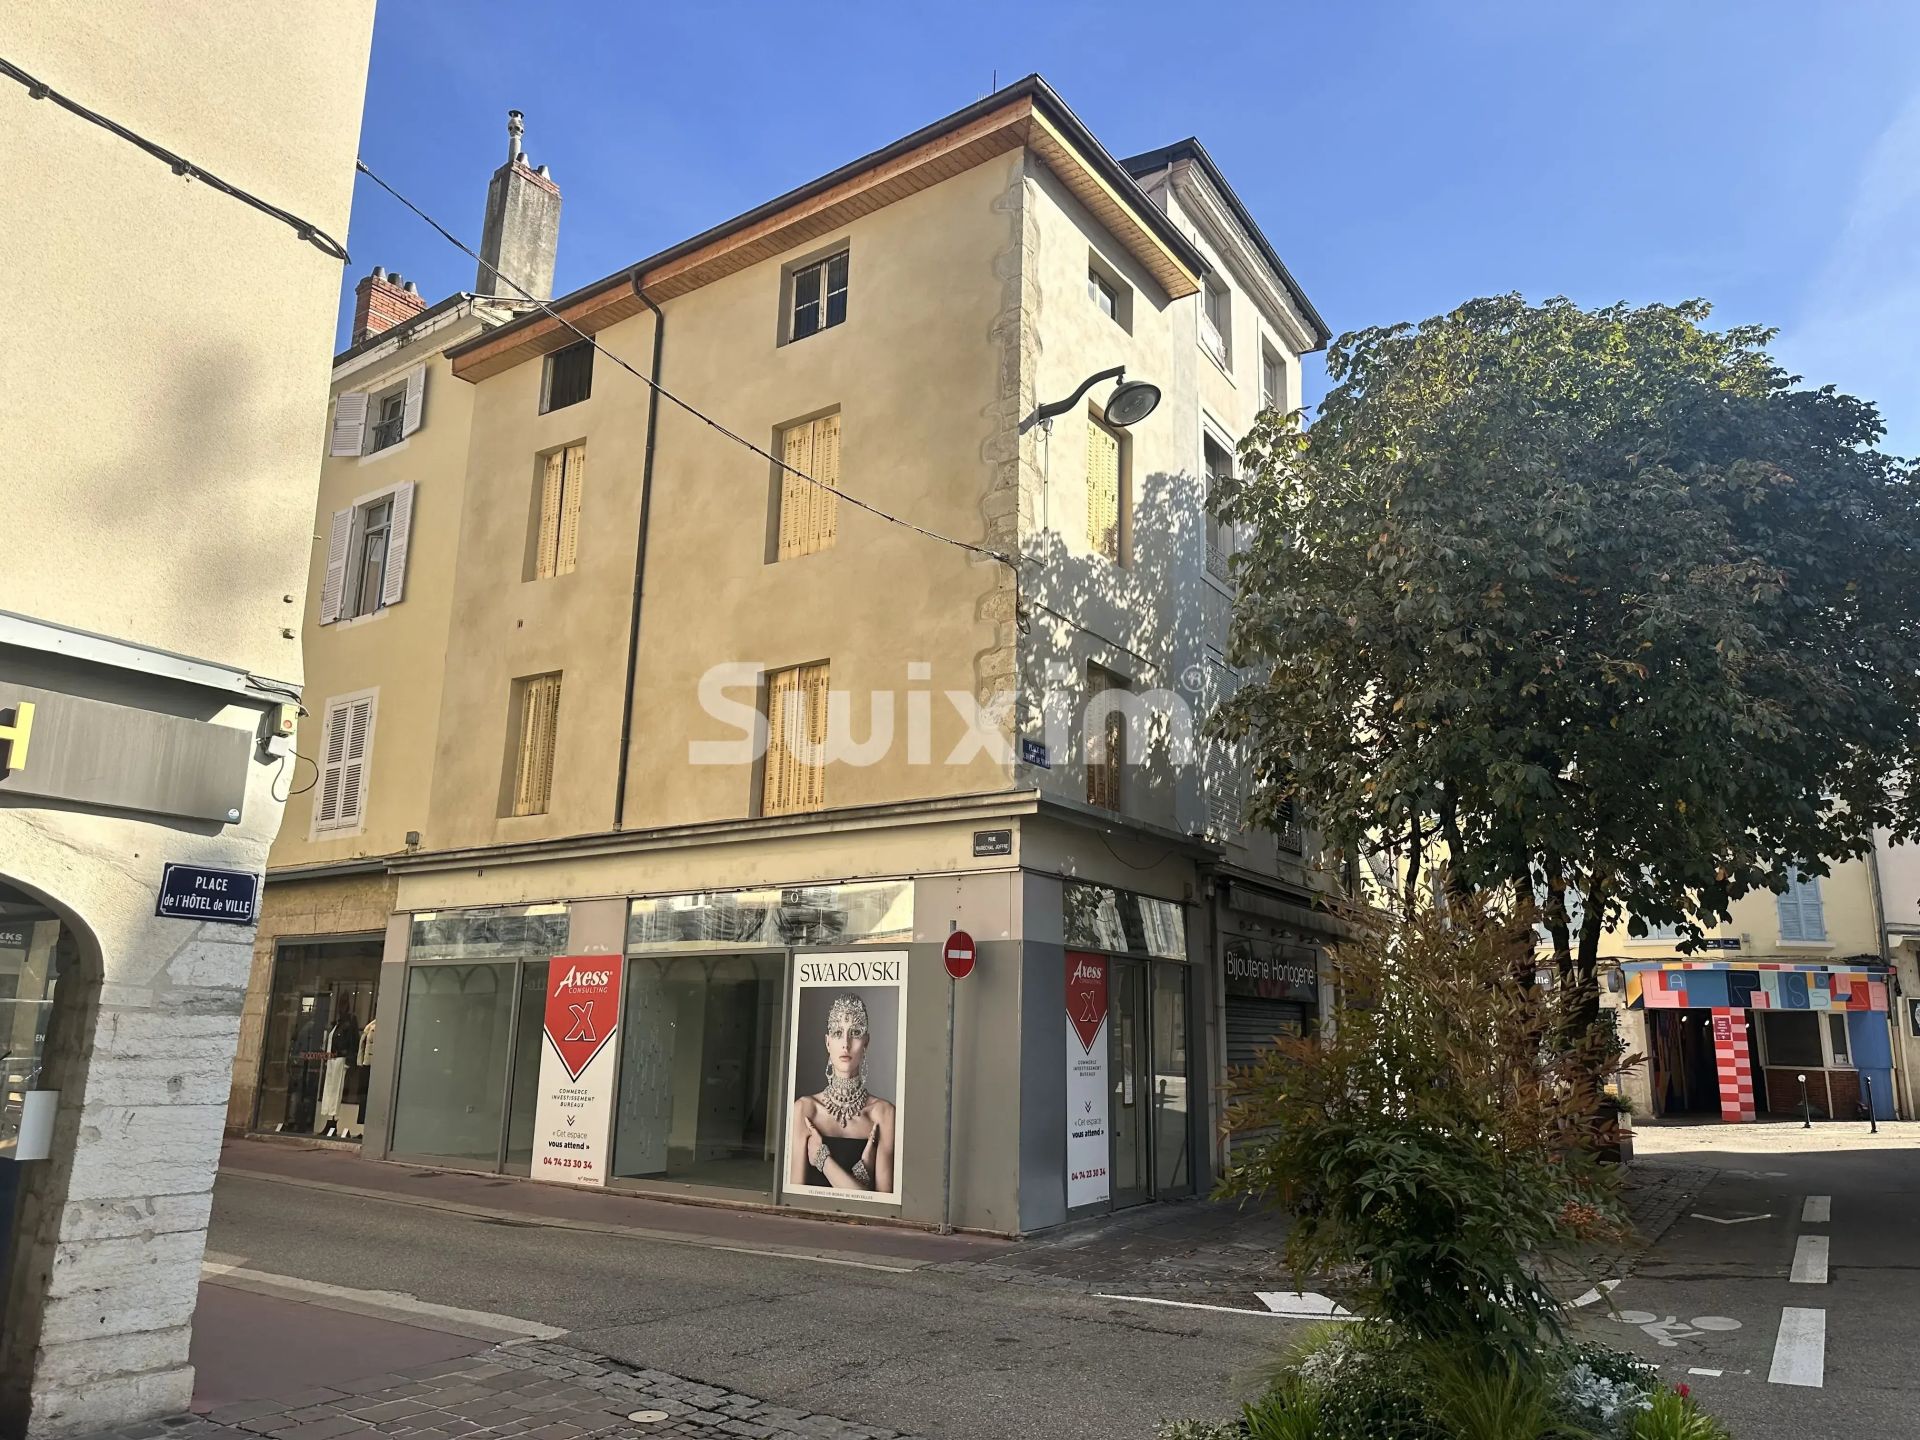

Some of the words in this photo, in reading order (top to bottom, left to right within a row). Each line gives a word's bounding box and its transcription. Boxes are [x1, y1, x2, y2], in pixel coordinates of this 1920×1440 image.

[195, 876, 229, 891] PLACE
[164, 893, 174, 906] de
[213, 898, 223, 910] de
[225, 899, 251, 913] VILLE
[800, 961, 901, 982] SWAROVSKI
[1070, 960, 1102, 985] Axess
[1227, 951, 1269, 981] Bijouterie
[1272, 959, 1314, 988] Horlogerie
[568, 986, 608, 994] CONSULTING
[551, 1094, 595, 1102] INVESTISSEMENT
[556, 1129, 566, 1138] Cet
[567, 1131, 588, 1140] espace
[1084, 1128, 1100, 1137] attend
[548, 1140, 563, 1148] vous
[564, 1141, 584, 1150] attend
[543, 1157, 552, 1165] 04
[554, 1157, 562, 1166] 74
[563, 1158, 572, 1167] 23
[573, 1159, 581, 1168] 30
[583, 1160, 592, 1169] 34
[1072, 1172, 1079, 1180] 04
[1079, 1171, 1086, 1179] 74
[1086, 1169, 1092, 1178] 23
[1092, 1168, 1099, 1177] 30
[1099, 1168, 1106, 1176] 34
